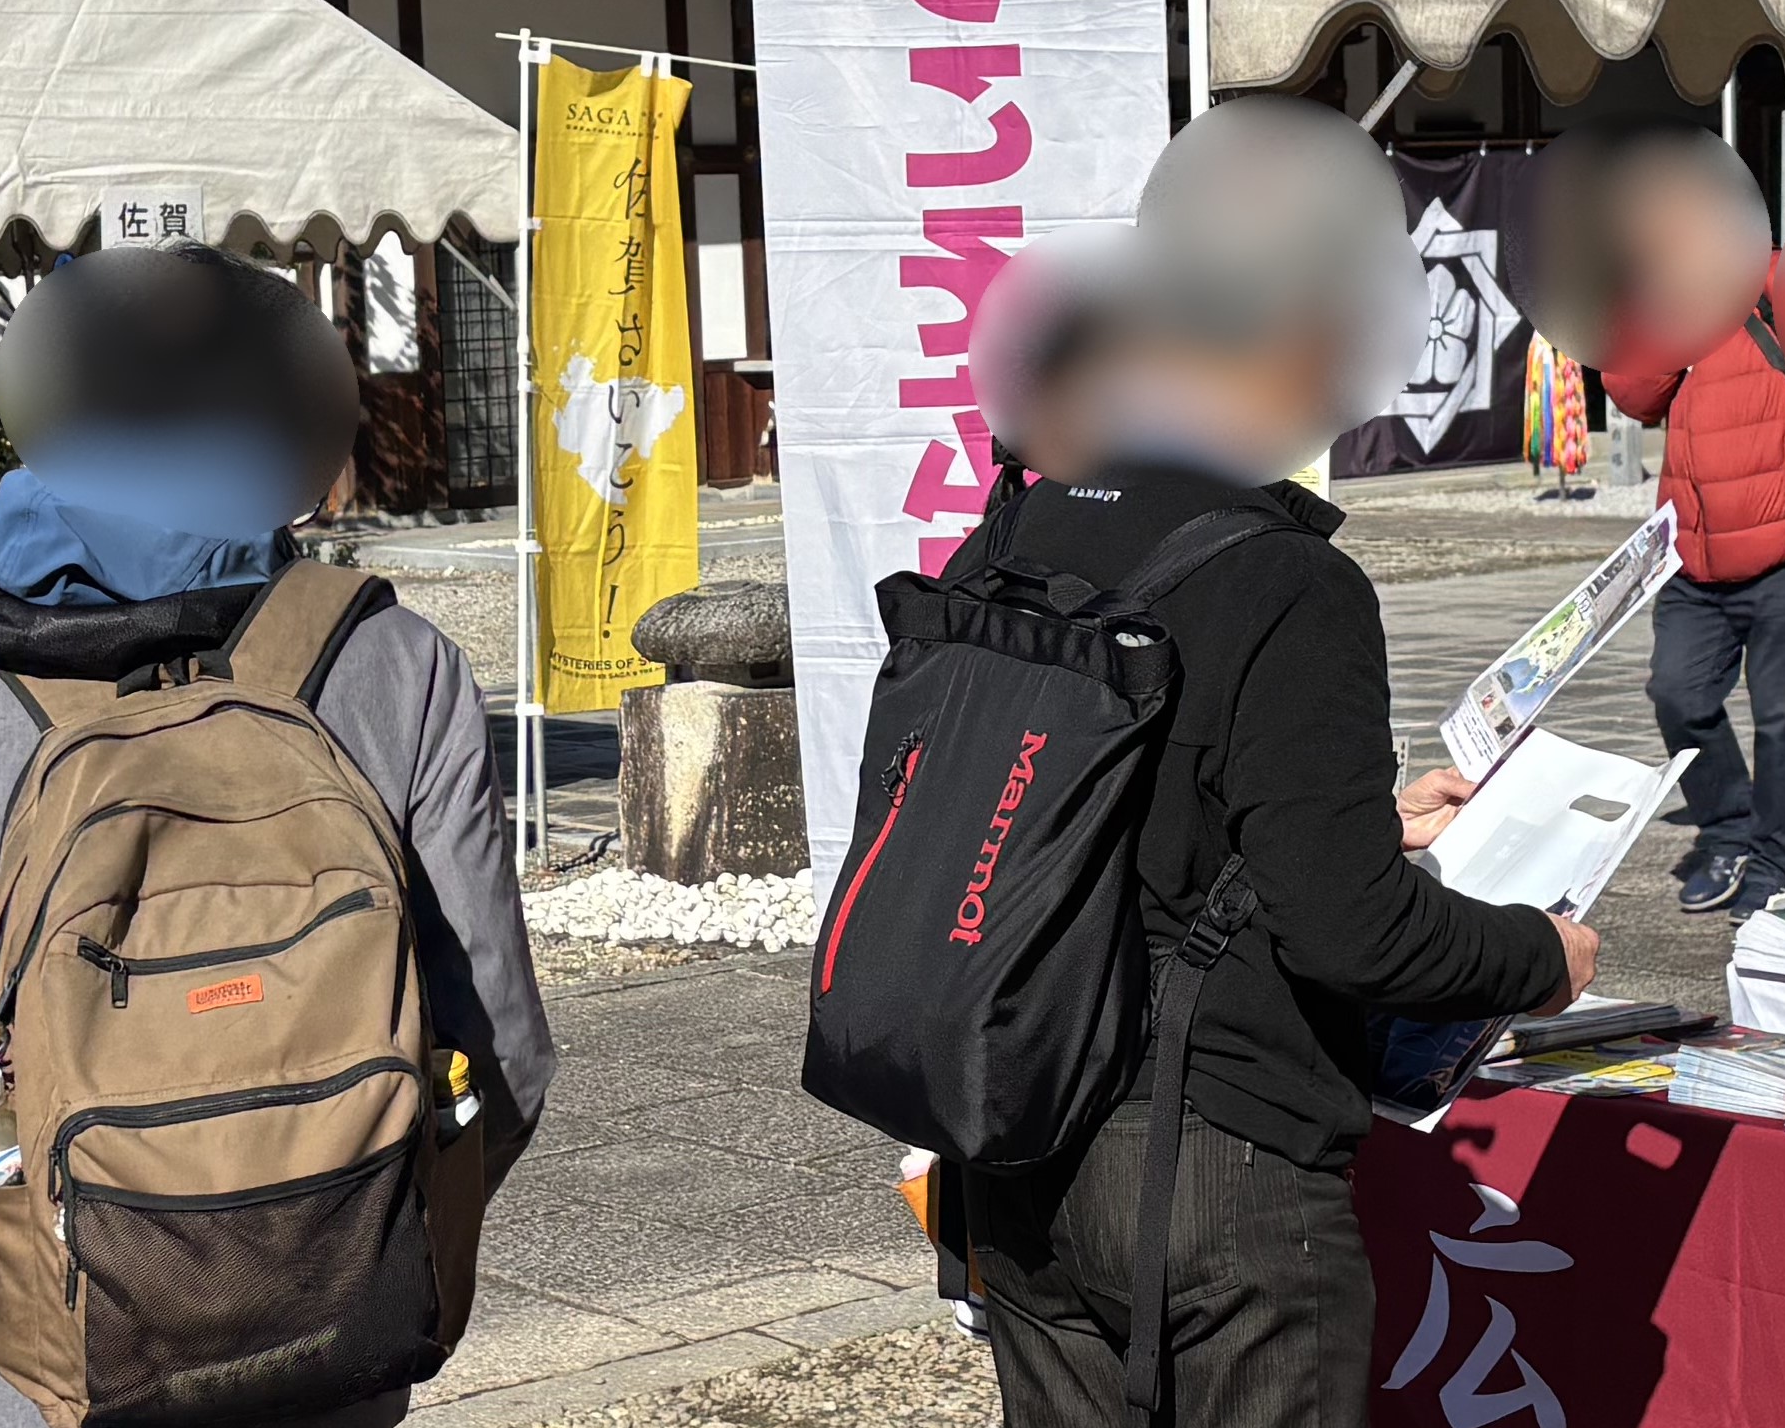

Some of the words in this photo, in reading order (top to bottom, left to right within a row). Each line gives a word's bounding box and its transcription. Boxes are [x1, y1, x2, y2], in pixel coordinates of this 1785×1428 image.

[565, 102, 631, 126] SAGA
[117, 201, 190, 239] 佐賀
[615, 657, 635, 670] OF
[949, 729, 1048, 947] Marmot
